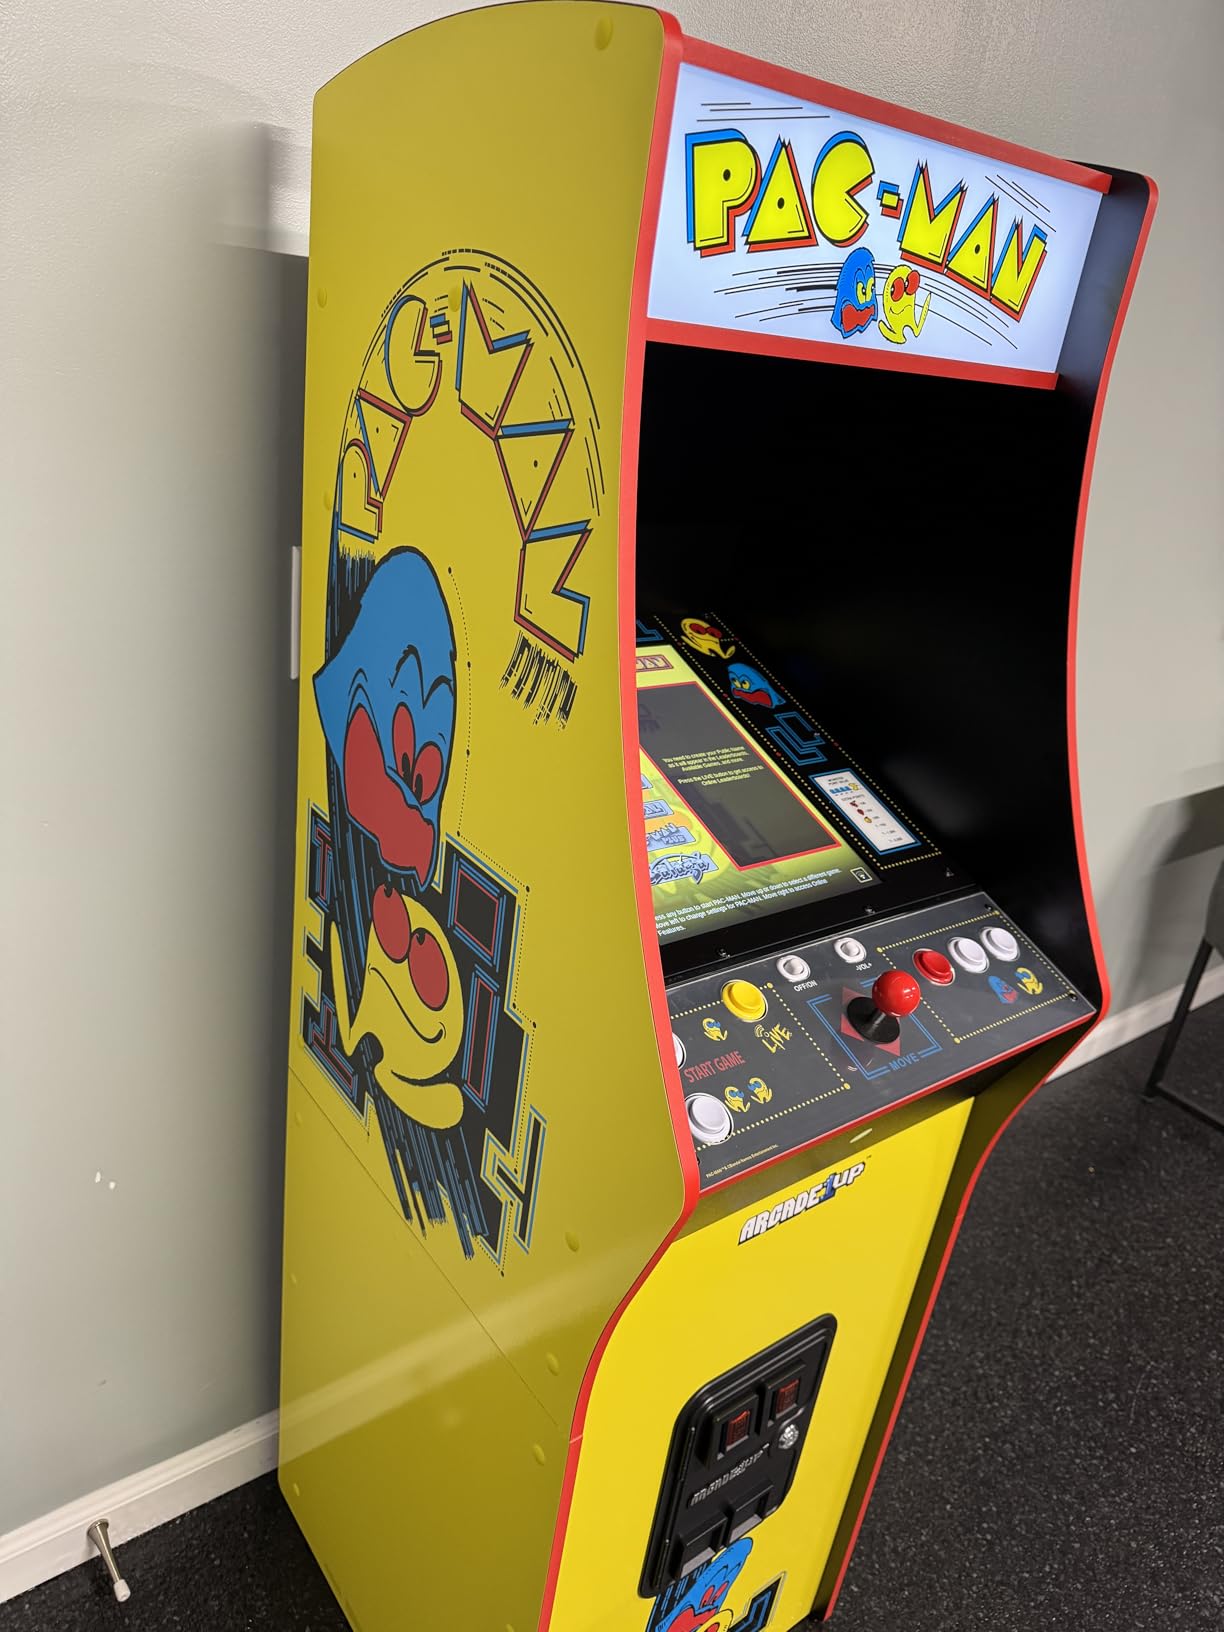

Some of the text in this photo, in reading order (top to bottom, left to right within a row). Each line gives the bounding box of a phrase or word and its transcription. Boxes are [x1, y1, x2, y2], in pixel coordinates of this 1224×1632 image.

[685, 128, 1047, 322] PAC-MAN
[337, 279, 592, 663] PAC-MAN
[676, 906, 694, 916] button
[700, 901, 714, 910] start
[742, 889, 756, 898] Move
[686, 909, 707, 920] change
[706, 904, 727, 915] settings
[762, 892, 778, 901] Move
[794, 980, 818, 992] OFF/ON
[684, 1050, 746, 1083] START GAME
[888, 1052, 920, 1071] MOVE
